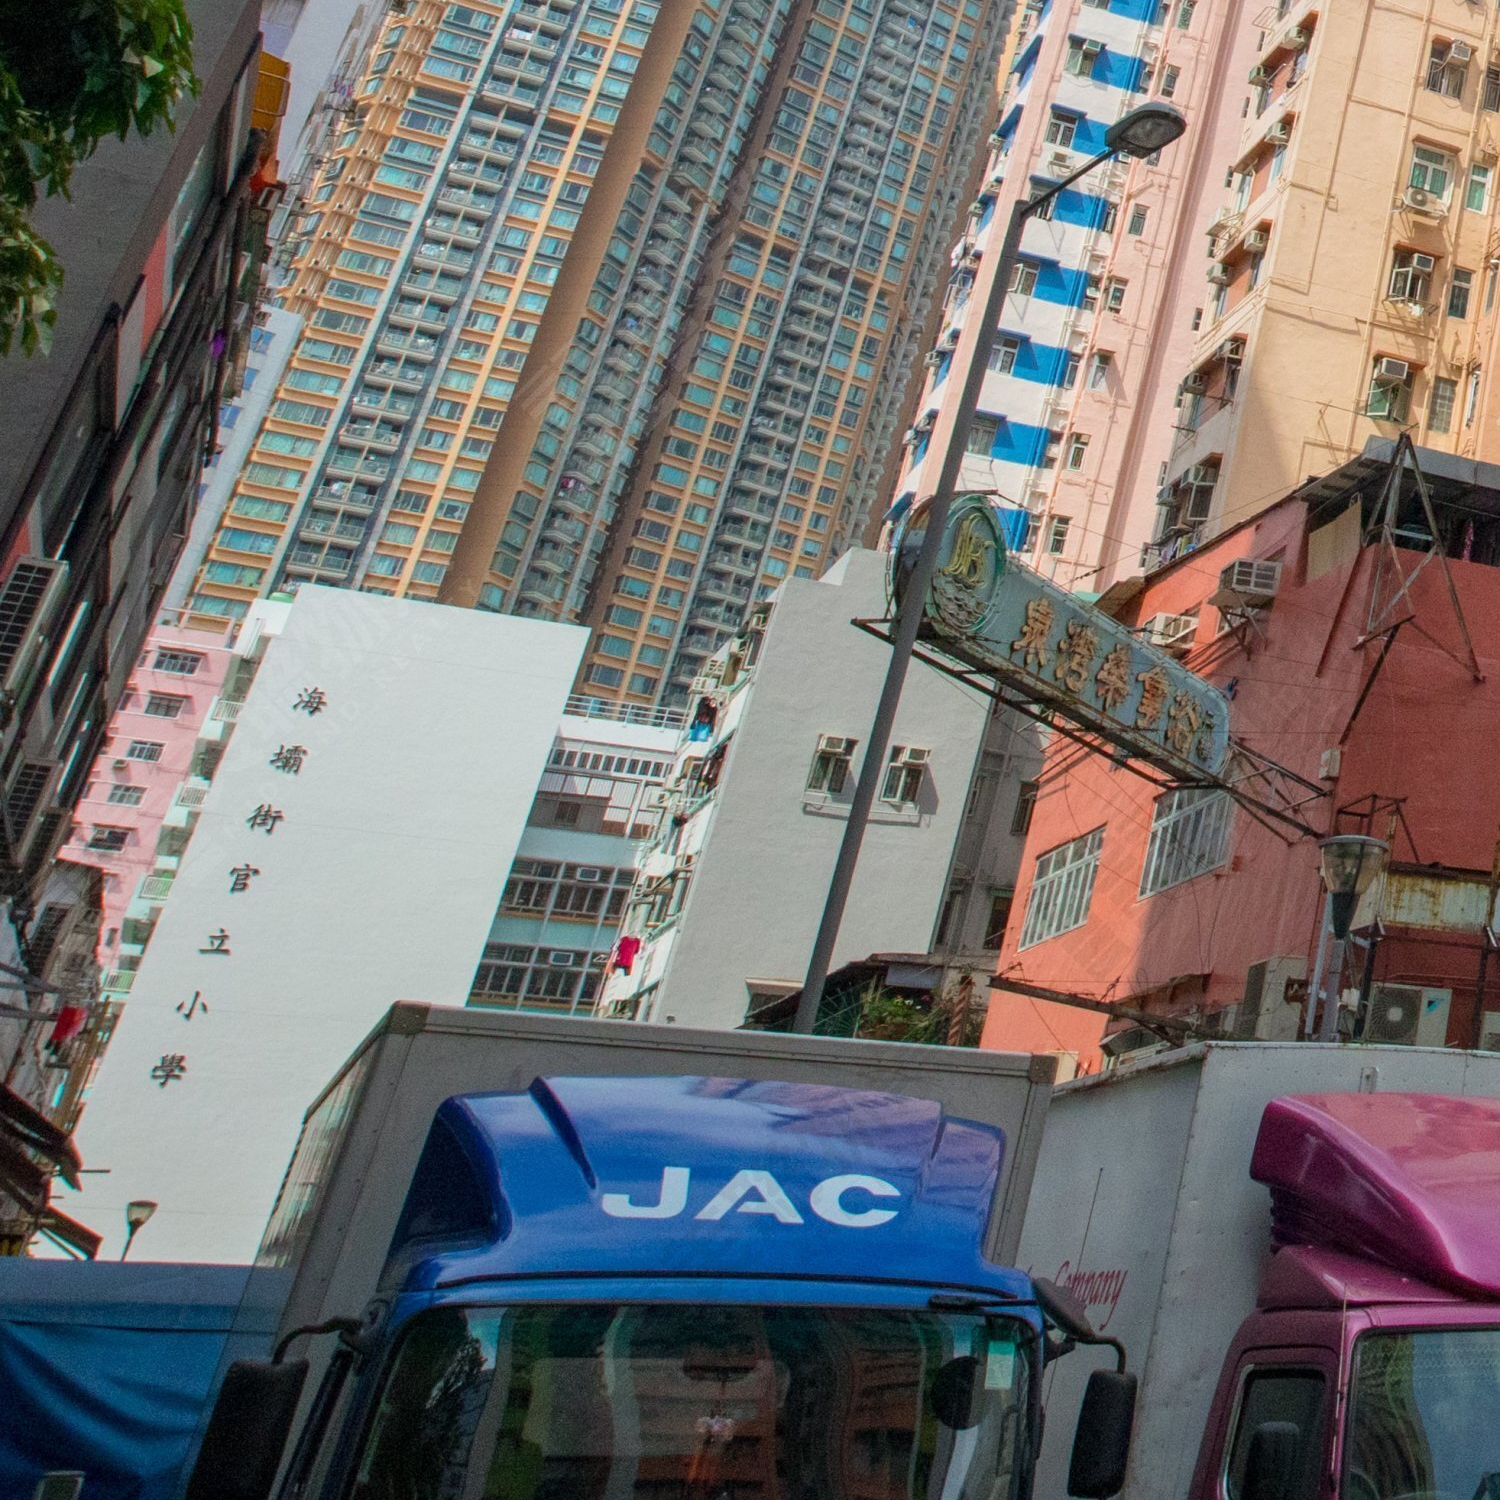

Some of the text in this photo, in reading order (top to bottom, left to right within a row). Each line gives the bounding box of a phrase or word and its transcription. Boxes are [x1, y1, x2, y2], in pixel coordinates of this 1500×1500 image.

[151, 686, 328, 1088] 海壩街官立小學
[602, 1166, 901, 1228] JAC
